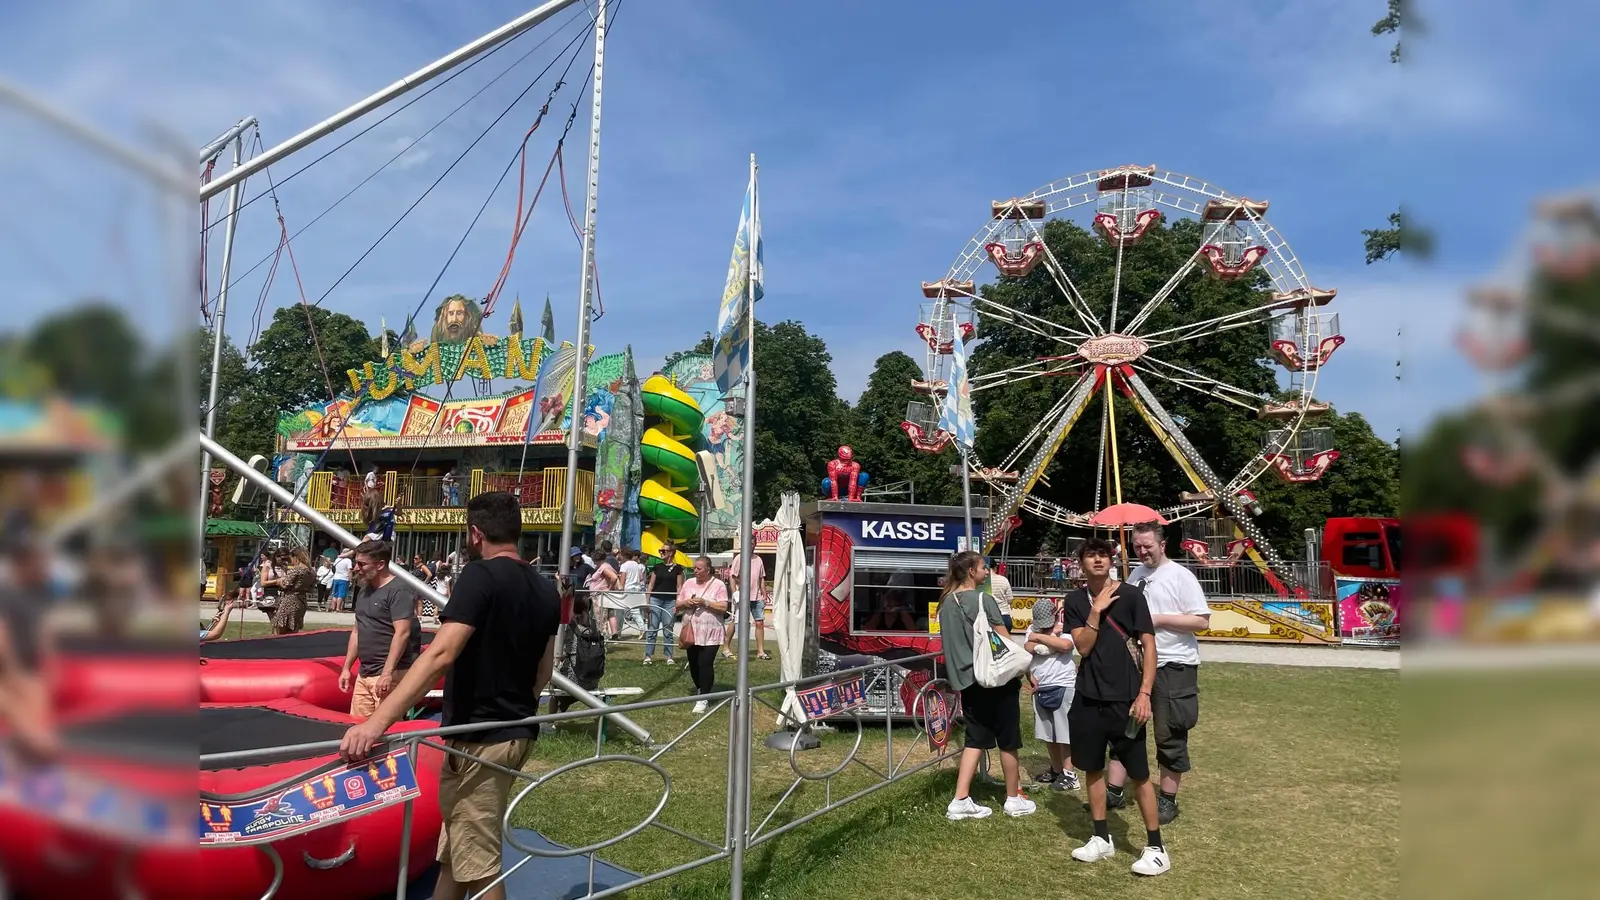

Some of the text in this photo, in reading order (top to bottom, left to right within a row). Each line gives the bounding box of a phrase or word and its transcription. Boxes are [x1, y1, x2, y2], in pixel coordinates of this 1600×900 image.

[347, 333, 596, 408] JUMAN
[861, 520, 945, 540] KASSE
[246, 814, 306, 833] TRAMPOLINE
